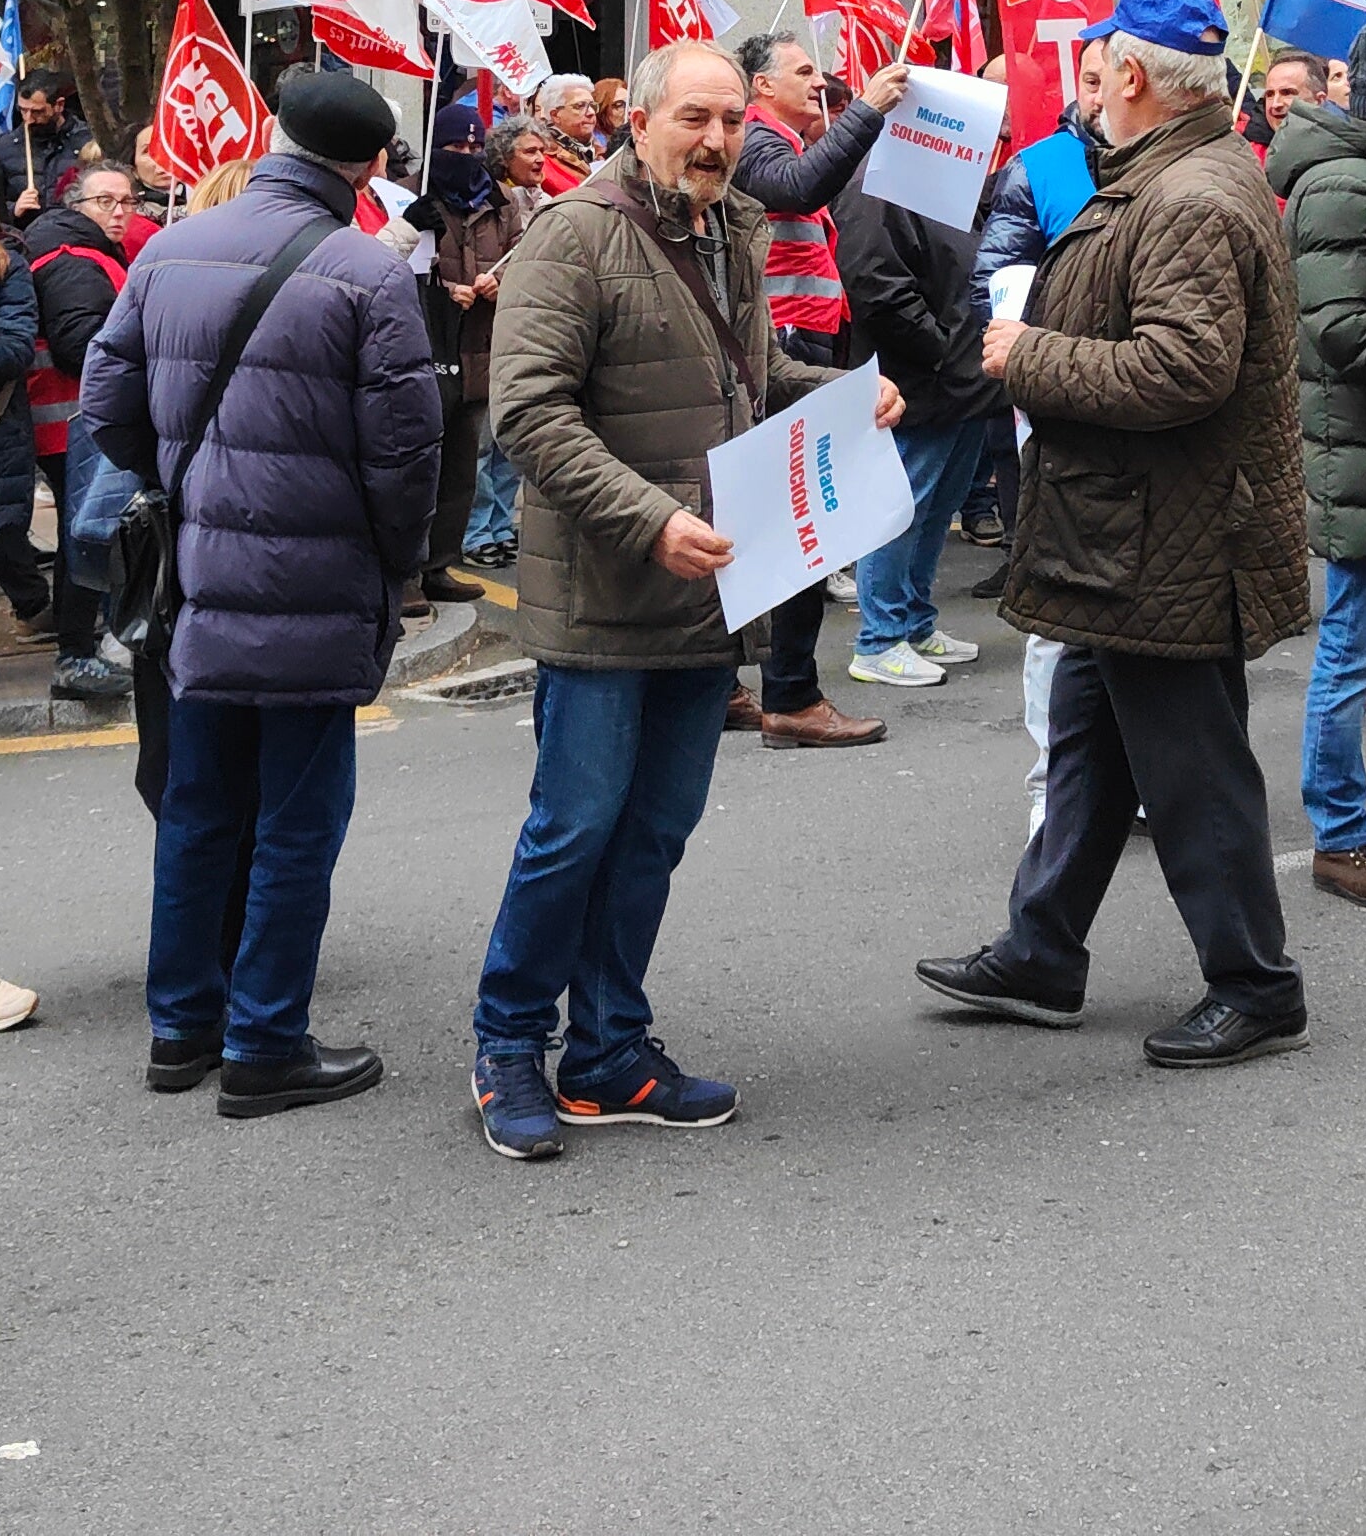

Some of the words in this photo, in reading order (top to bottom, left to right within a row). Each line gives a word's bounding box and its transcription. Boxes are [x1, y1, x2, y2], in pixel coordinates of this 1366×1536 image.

[889, 122, 952, 157] SOLUCIÓN
[955, 145, 974, 162] XA
[916, 105, 965, 132] Muface
[788, 417, 810, 521] SOLUCIÓN
[816, 431, 839, 515] Muface
